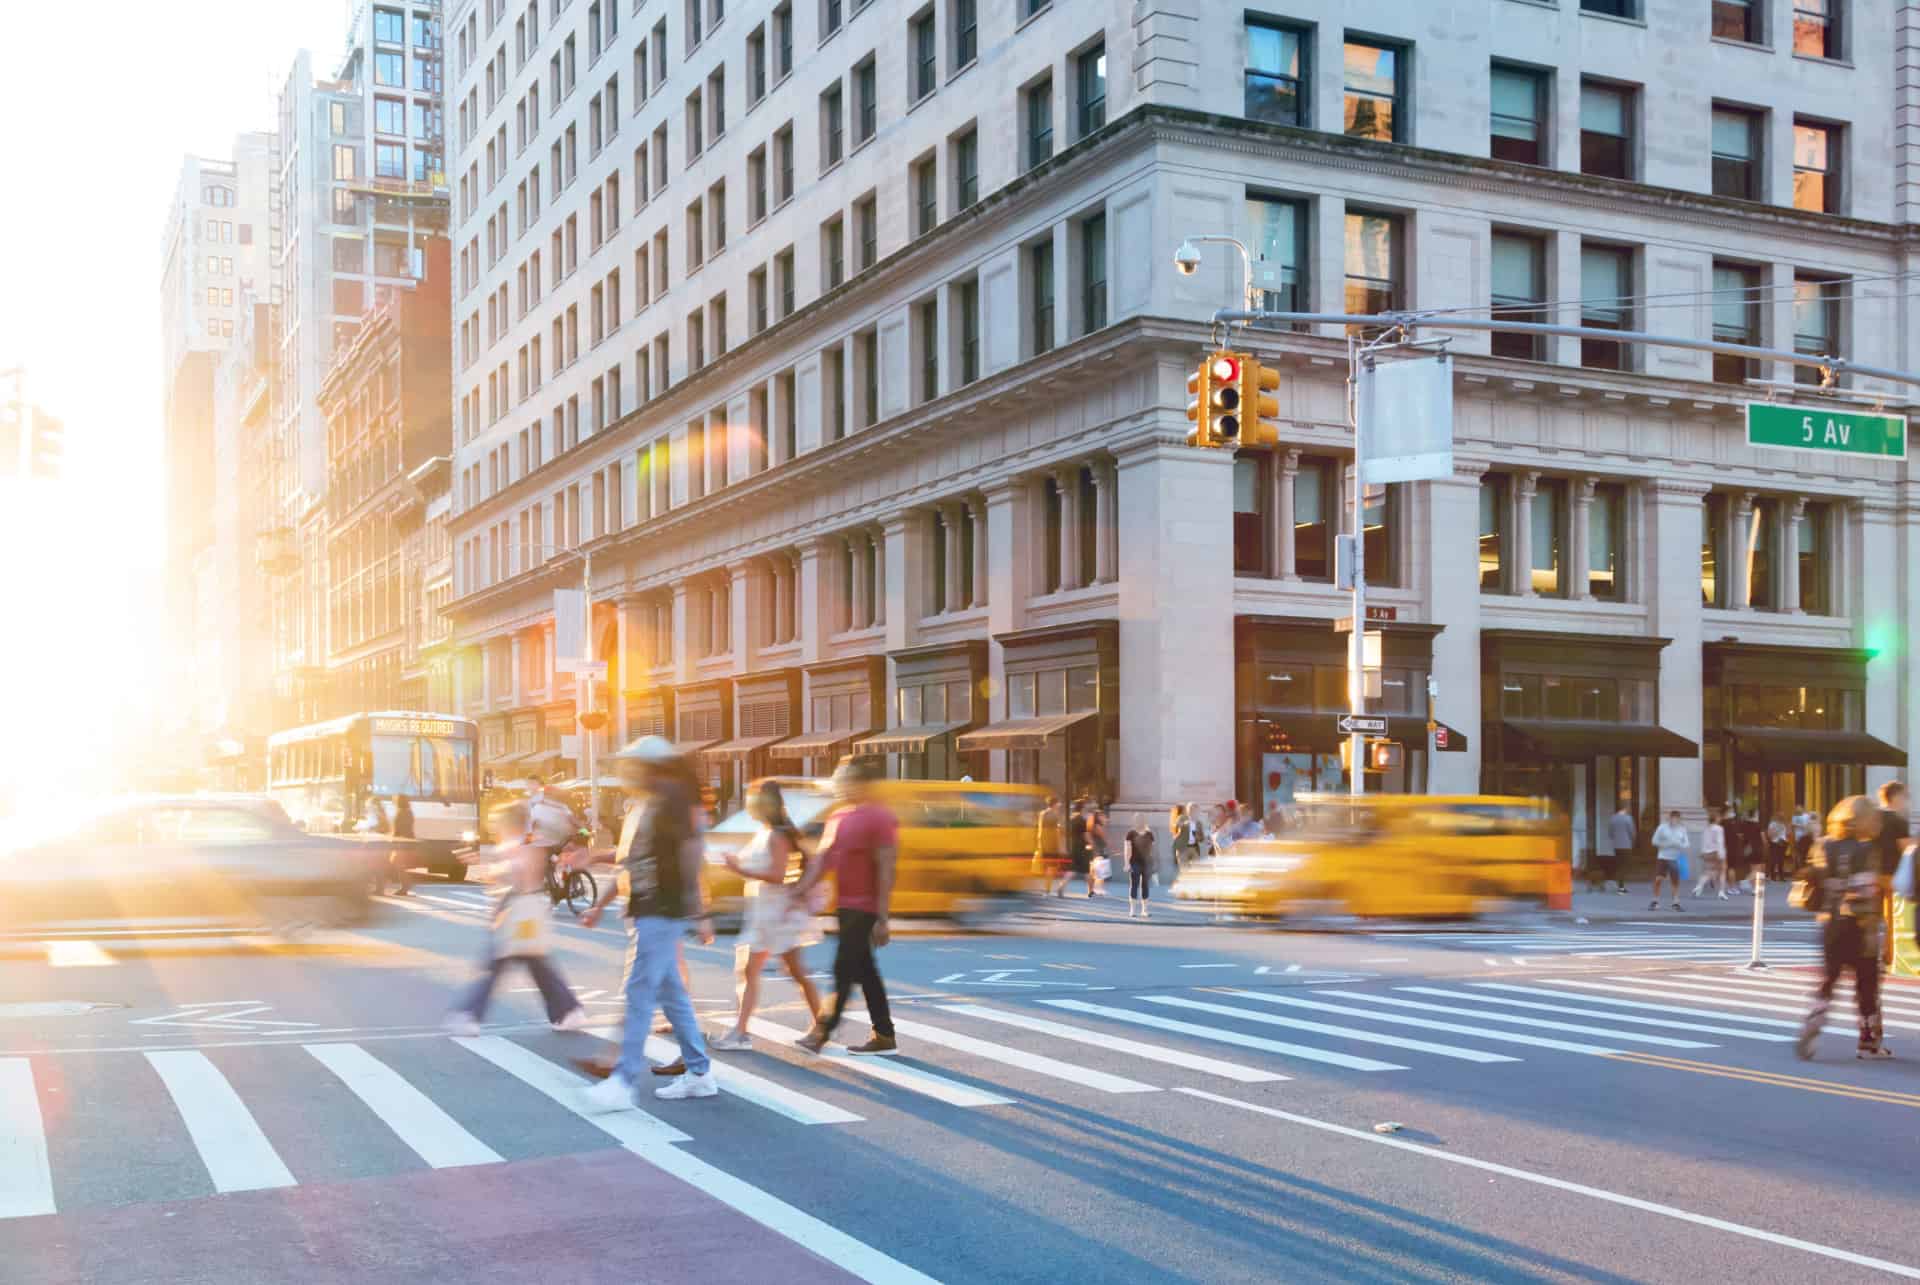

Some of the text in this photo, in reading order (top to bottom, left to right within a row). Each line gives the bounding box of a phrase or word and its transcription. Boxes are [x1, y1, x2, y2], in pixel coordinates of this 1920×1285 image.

[1803, 416, 1850, 445] 5 Av
[375, 719, 454, 733] MASKS REQUIRED
[1345, 719, 1384, 729] ONE WAY
